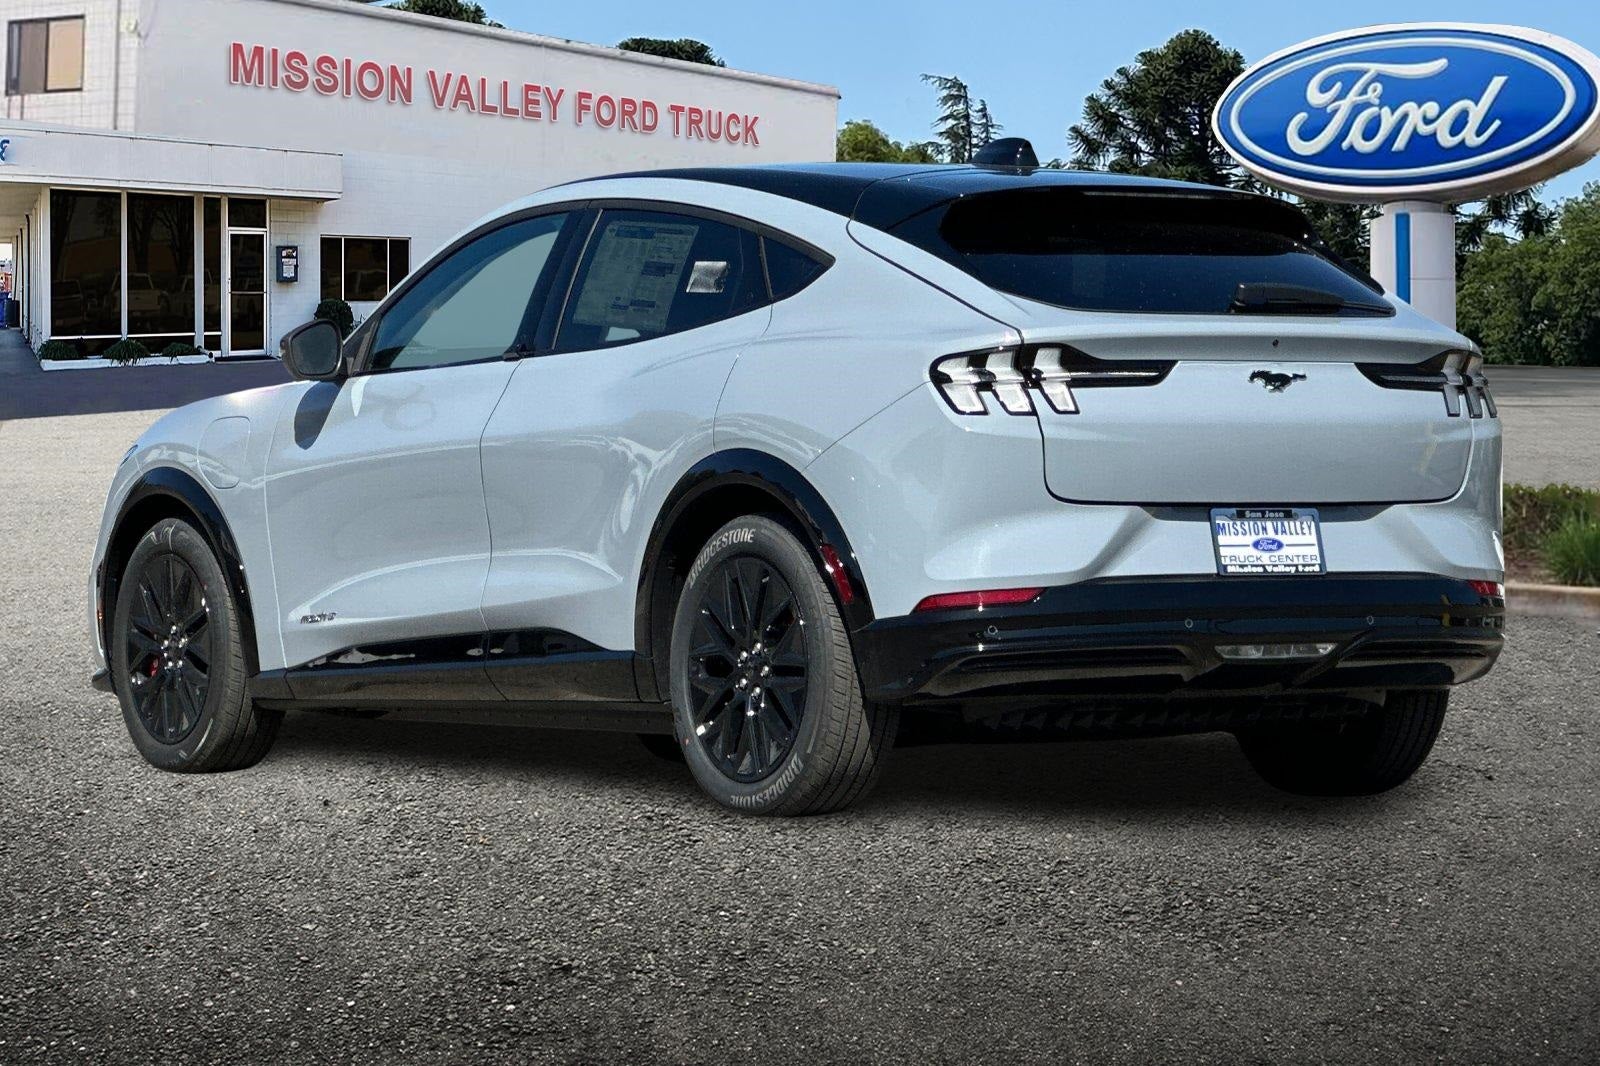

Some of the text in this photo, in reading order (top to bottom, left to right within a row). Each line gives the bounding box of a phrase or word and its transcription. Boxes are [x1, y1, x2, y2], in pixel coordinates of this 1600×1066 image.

[229, 42, 760, 145] MISSION VALLEY FORD TRUCK
[1286, 57, 1508, 156] Ford
[1244, 510, 1262, 518] San
[1216, 521, 1313, 537] MISSION VALLEY
[1257, 538, 1279, 550] Ford
[689, 527, 756, 589] BRIDGESTONE
[1222, 554, 1318, 564] TRUCK CENTER
